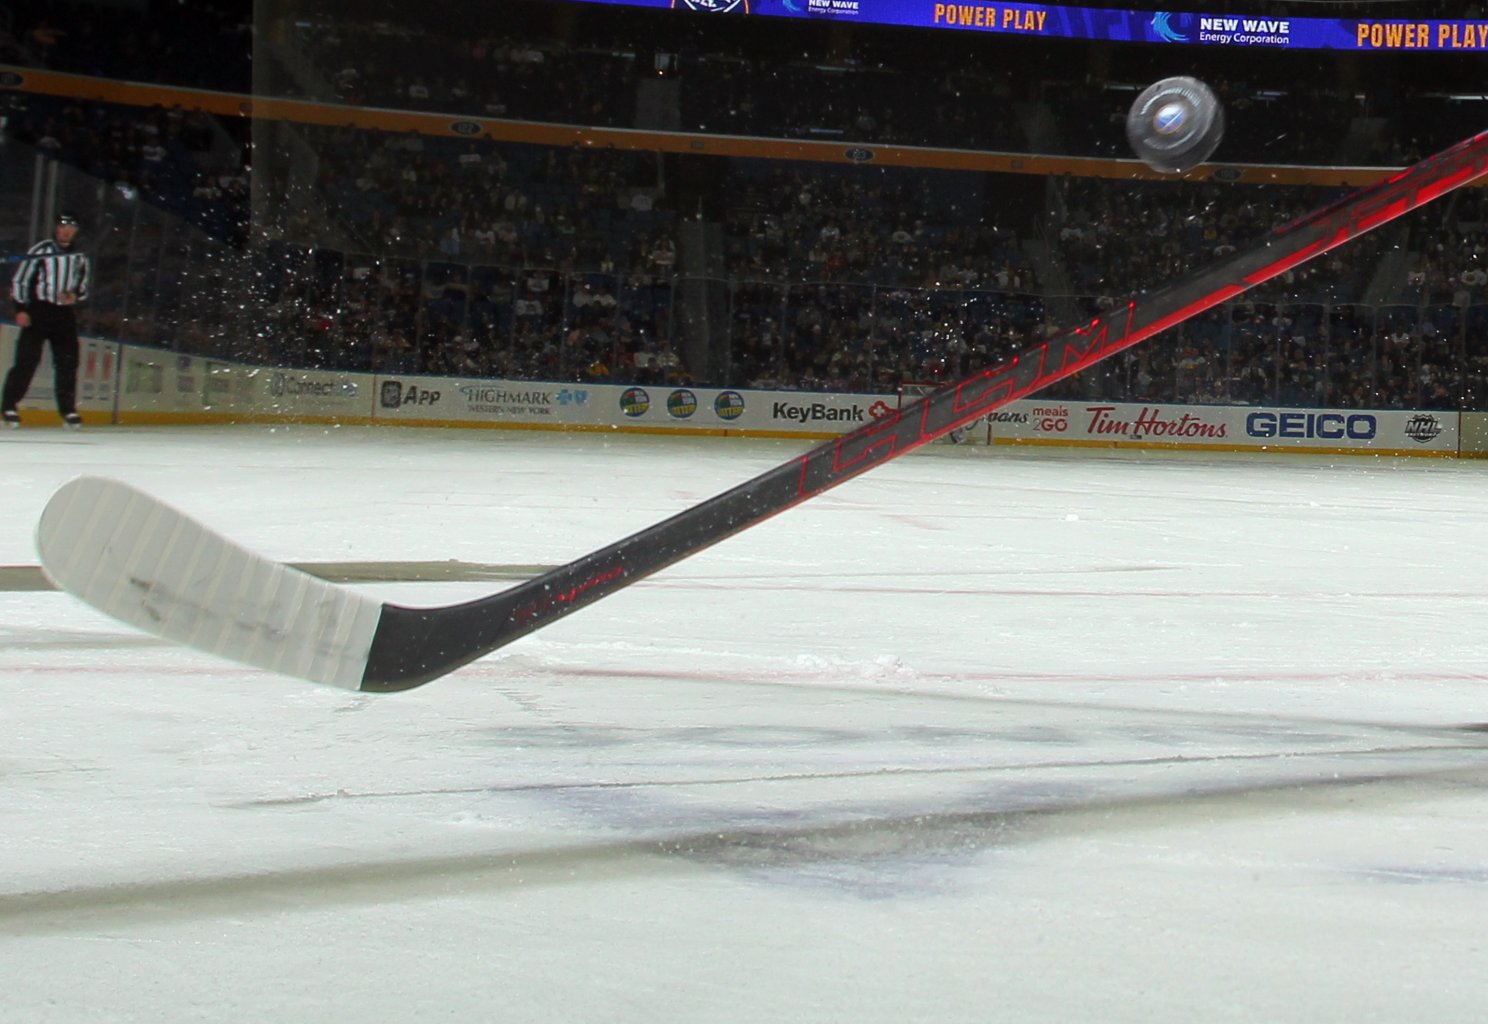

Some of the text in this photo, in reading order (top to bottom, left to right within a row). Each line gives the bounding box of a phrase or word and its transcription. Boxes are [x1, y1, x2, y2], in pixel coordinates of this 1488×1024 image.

[808, 6, 860, 16] Energy Corporation
[832, 0, 860, 10] WAVE
[934, 4, 1047, 32] POWER PLAY
[1200, 18, 1290, 34] NEW WAVE
[1199, 32, 1290, 45] Energy Corporation
[1356, 23, 1429, 48] POWER
[404, 386, 441, 406] App
[468, 388, 551, 404] HIGHMARK
[507, 406, 525, 415] NEW
[528, 406, 550, 415] YORK
[773, 402, 864, 423] KeyBank
[1032, 405, 1069, 416] meals
[1033, 418, 1068, 432] 2GO
[1086, 406, 1227, 438] Tim Hortons
[1246, 412, 1377, 439] GEICO
[1405, 419, 1442, 435] NHL
